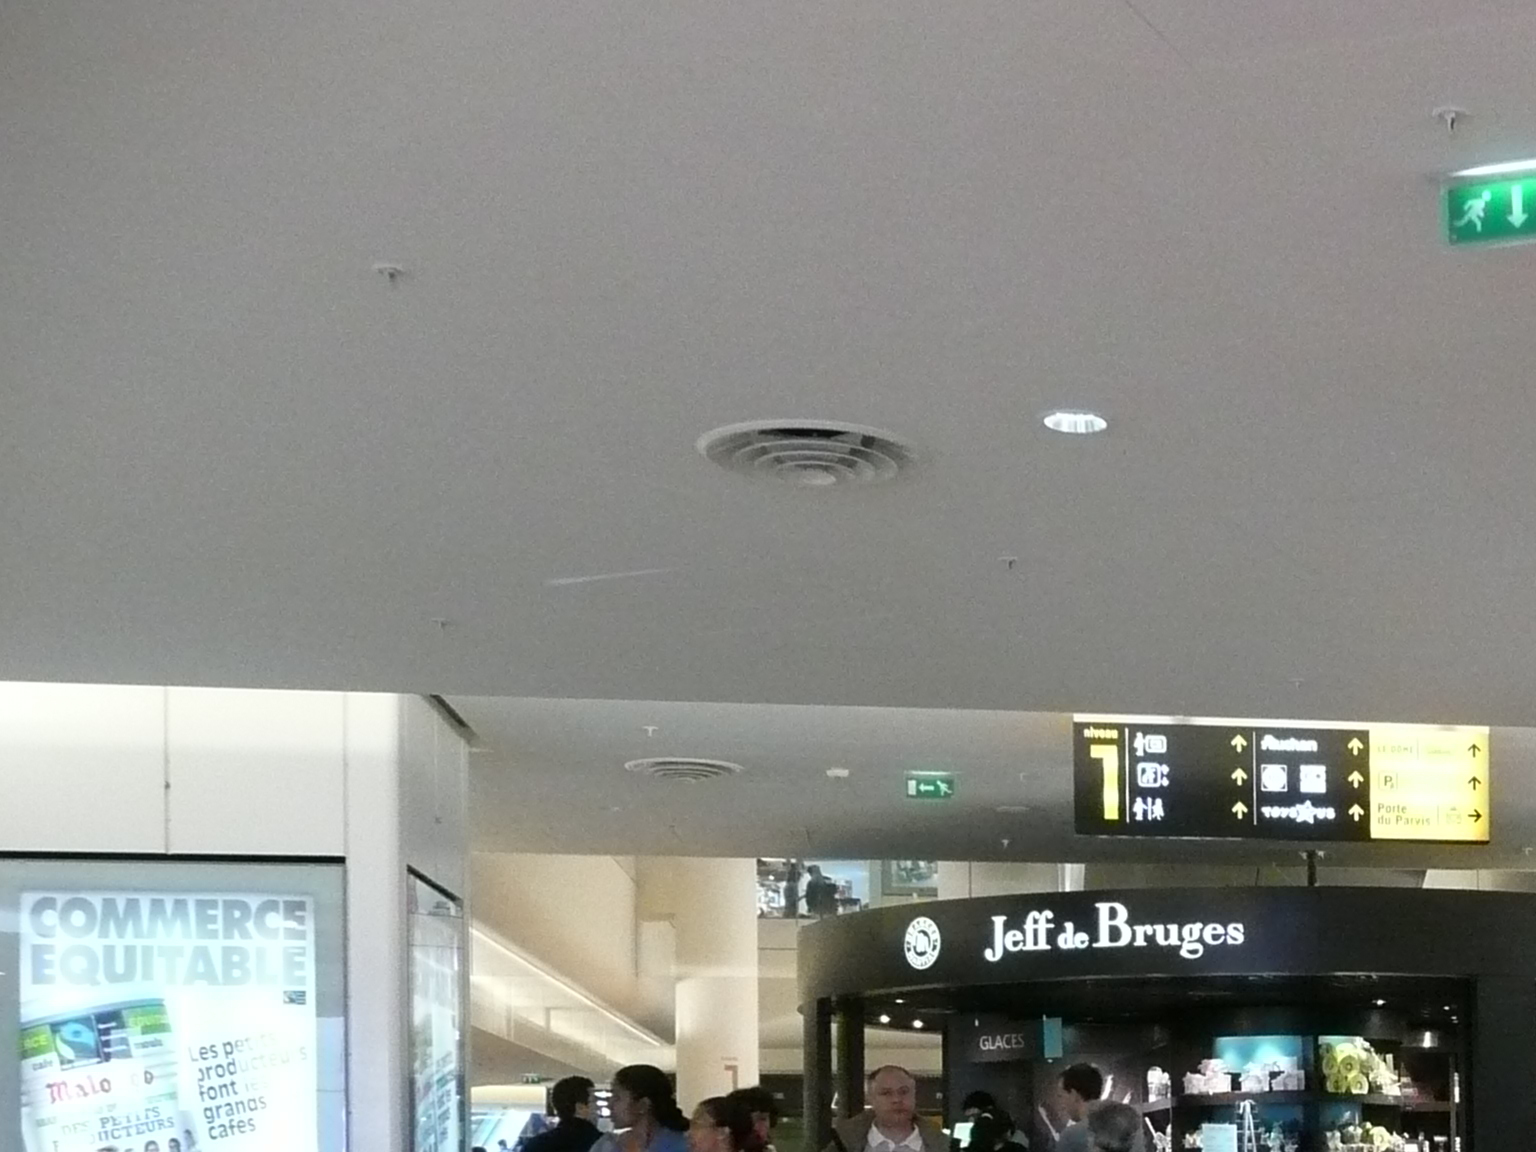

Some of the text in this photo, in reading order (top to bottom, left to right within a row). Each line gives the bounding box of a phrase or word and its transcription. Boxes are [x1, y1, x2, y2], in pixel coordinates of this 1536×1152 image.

[1083, 727, 1118, 740] niveau
[1260, 734, 1318, 752] Auchan
[1090, 745, 1119, 820] 1
[1377, 803, 1407, 814] Porte
[1377, 815, 1431, 826] du Parvis
[29, 896, 307, 940] COMMERCE
[984, 909, 1055, 962] Jeff
[1057, 921, 1090, 950] de
[1091, 901, 1245, 959] Bruges
[30, 943, 307, 987] EQUITABLE
[188, 1043, 219, 1063] Les
[979, 1033, 1025, 1051] GLACES
[197, 1045, 308, 1083] producteus
[45, 1069, 155, 1105] Malogo
[198, 1078, 239, 1102] font
